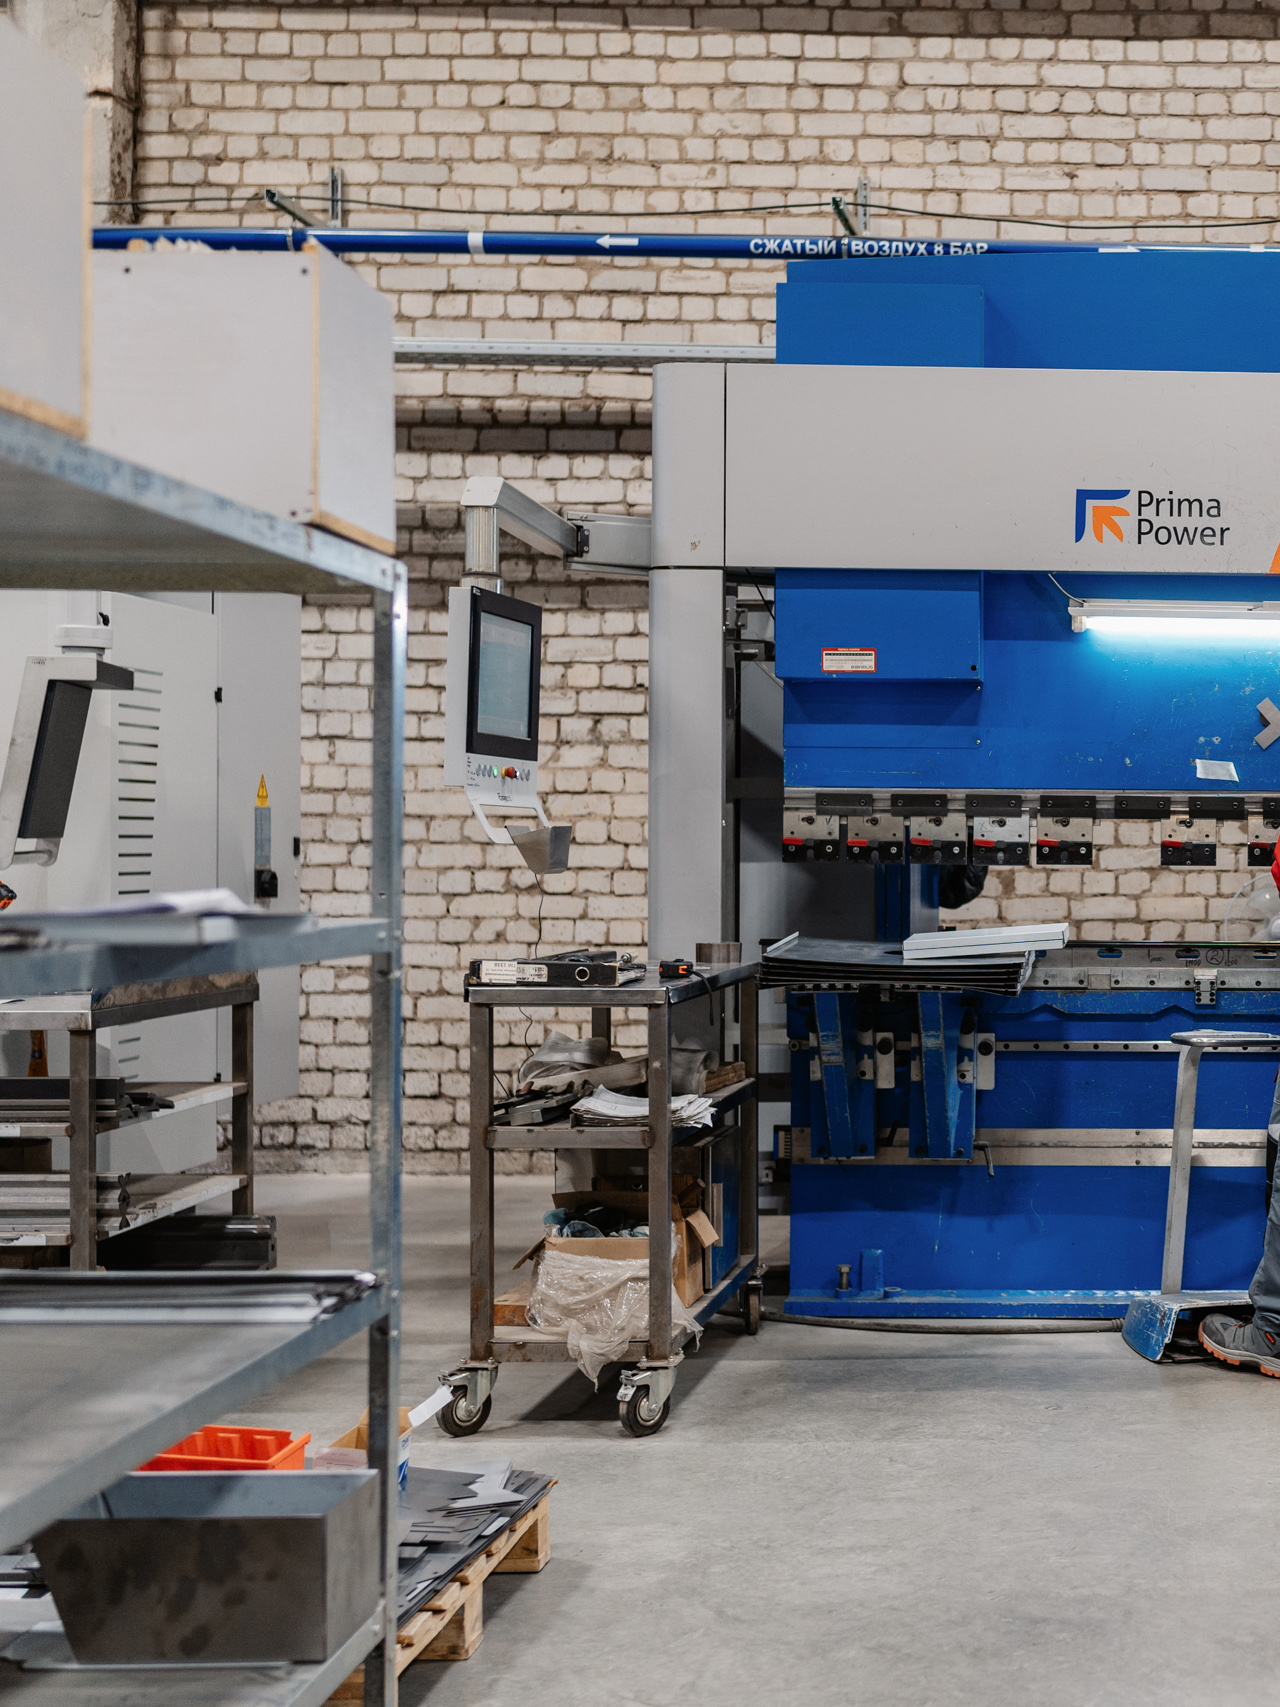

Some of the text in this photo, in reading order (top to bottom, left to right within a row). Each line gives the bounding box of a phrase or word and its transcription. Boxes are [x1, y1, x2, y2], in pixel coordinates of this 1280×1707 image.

[749, 237, 989, 257] СЖАТЫЙ ВОЗДУХ 8 БАР
[1136, 489, 1222, 518] Prima
[1136, 518, 1231, 546] Power
